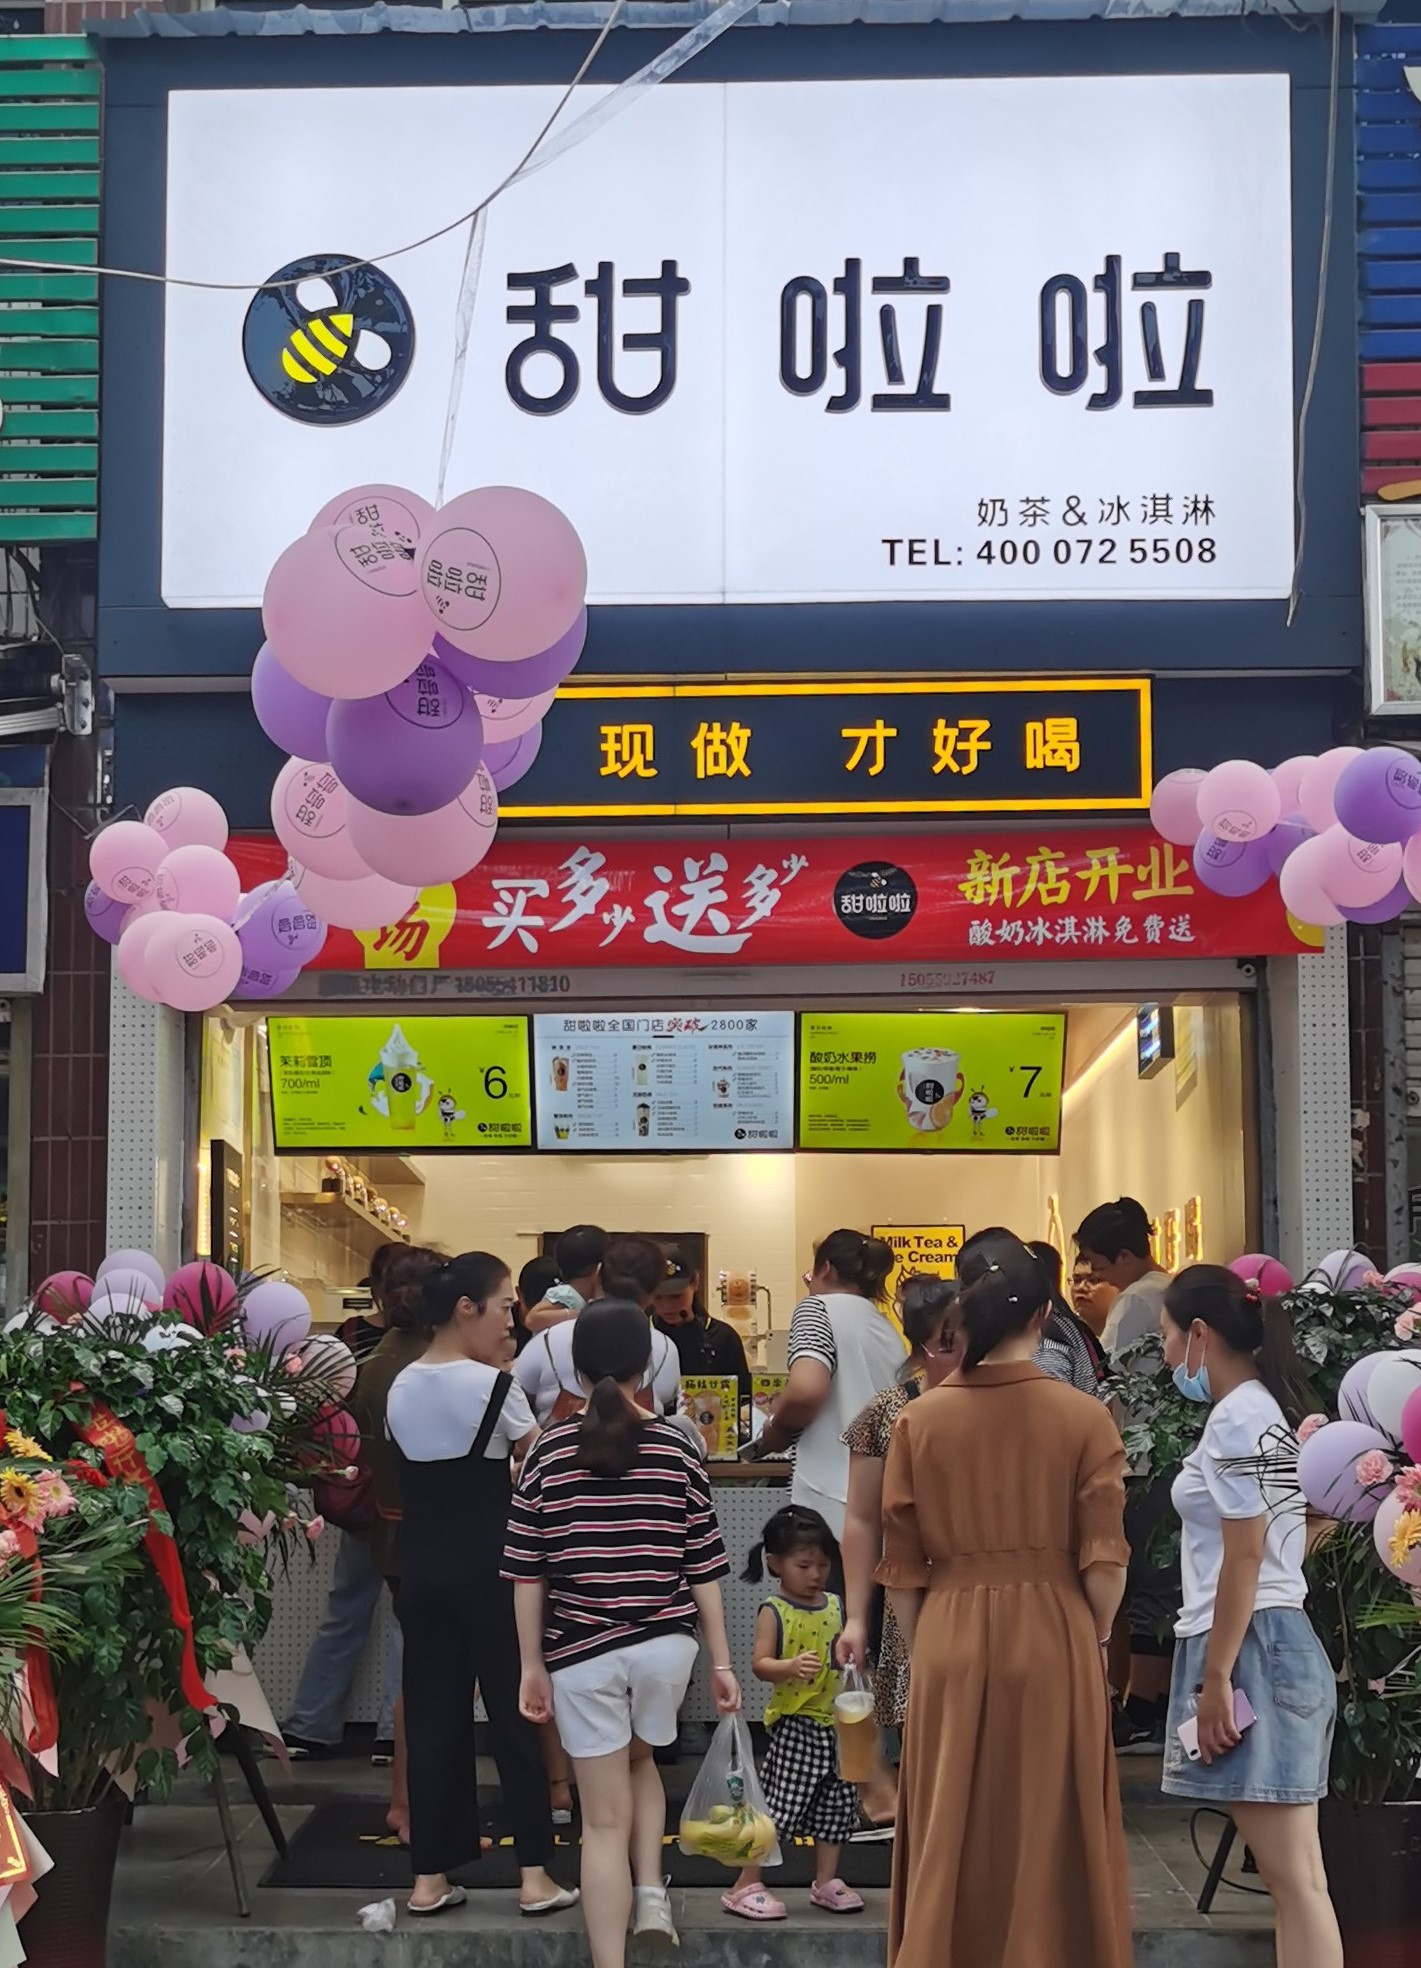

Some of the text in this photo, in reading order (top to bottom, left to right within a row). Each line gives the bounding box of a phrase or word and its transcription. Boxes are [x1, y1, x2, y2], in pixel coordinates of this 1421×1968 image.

[505, 252, 1214, 415] 甜啦啦
[977, 494, 1216, 527] 奶茶&冰淇淋
[883, 537, 1216, 566] TEL: 400 072 5508
[958, 843, 1195, 908] 新店开业
[482, 845, 809, 953] 买多少送多少
[841, 893, 911, 913] 甜啦啦
[968, 913, 1196, 947] 酸奶冰淇淋免费送
[914, 1236, 943, 1248] Tea
[946, 1236, 959, 1248] &
